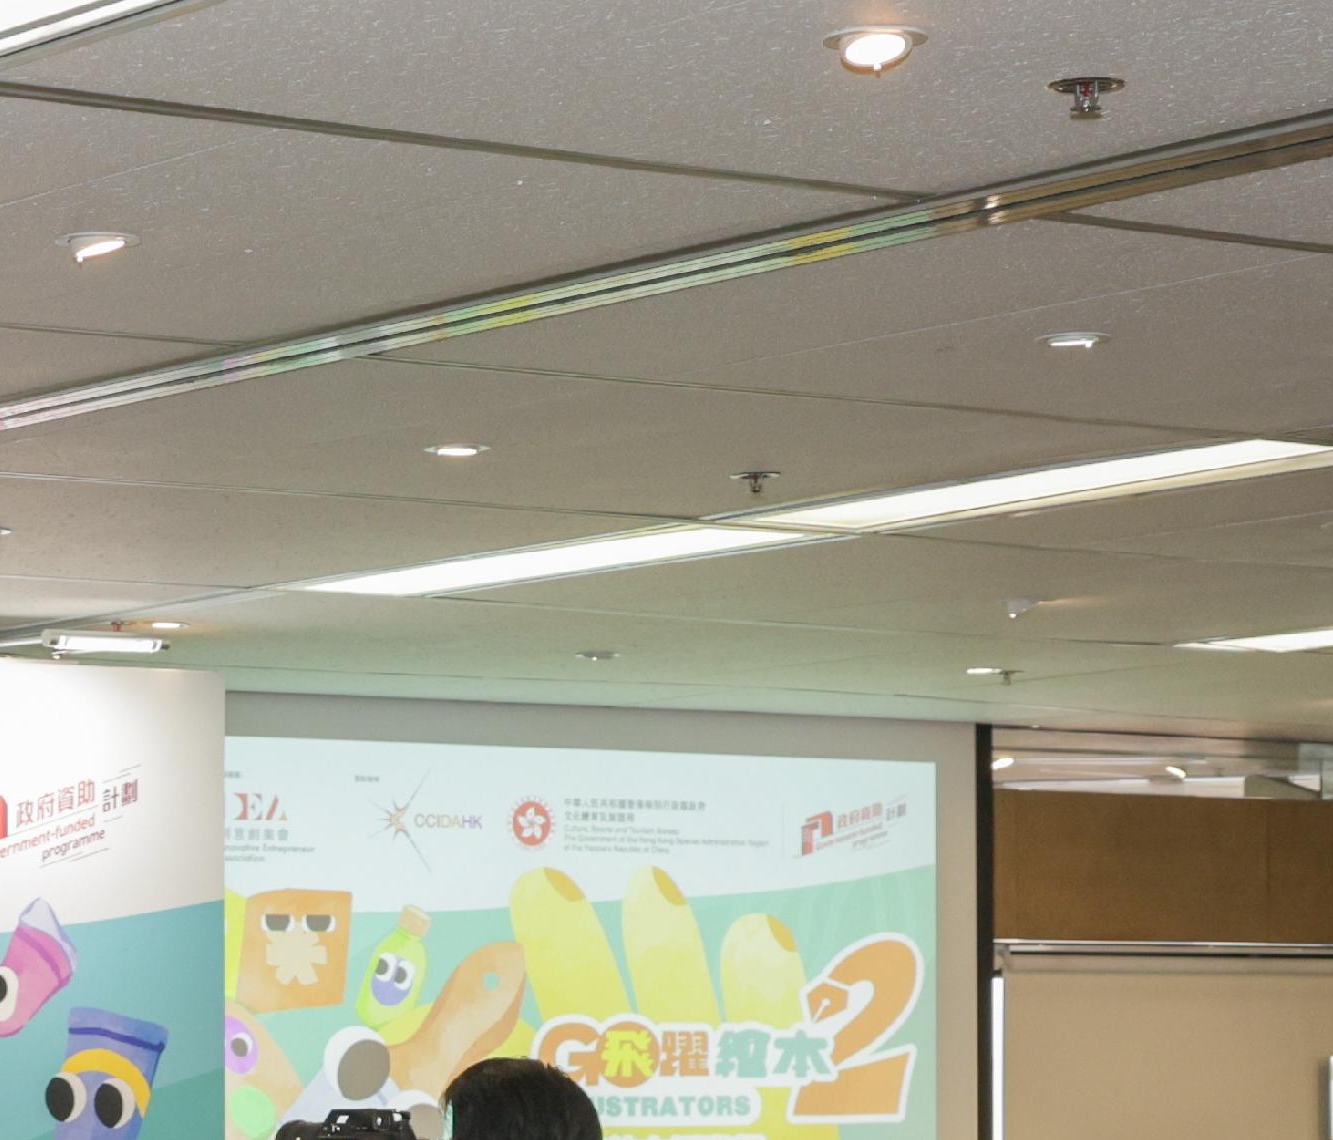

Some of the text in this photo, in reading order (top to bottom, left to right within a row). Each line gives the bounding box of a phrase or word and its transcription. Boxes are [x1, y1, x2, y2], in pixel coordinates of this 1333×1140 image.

[16, 779, 139, 828] 政府資助 計劃
[414, 813, 483, 829] CCIDAHK
[41, 829, 106, 863] programme
